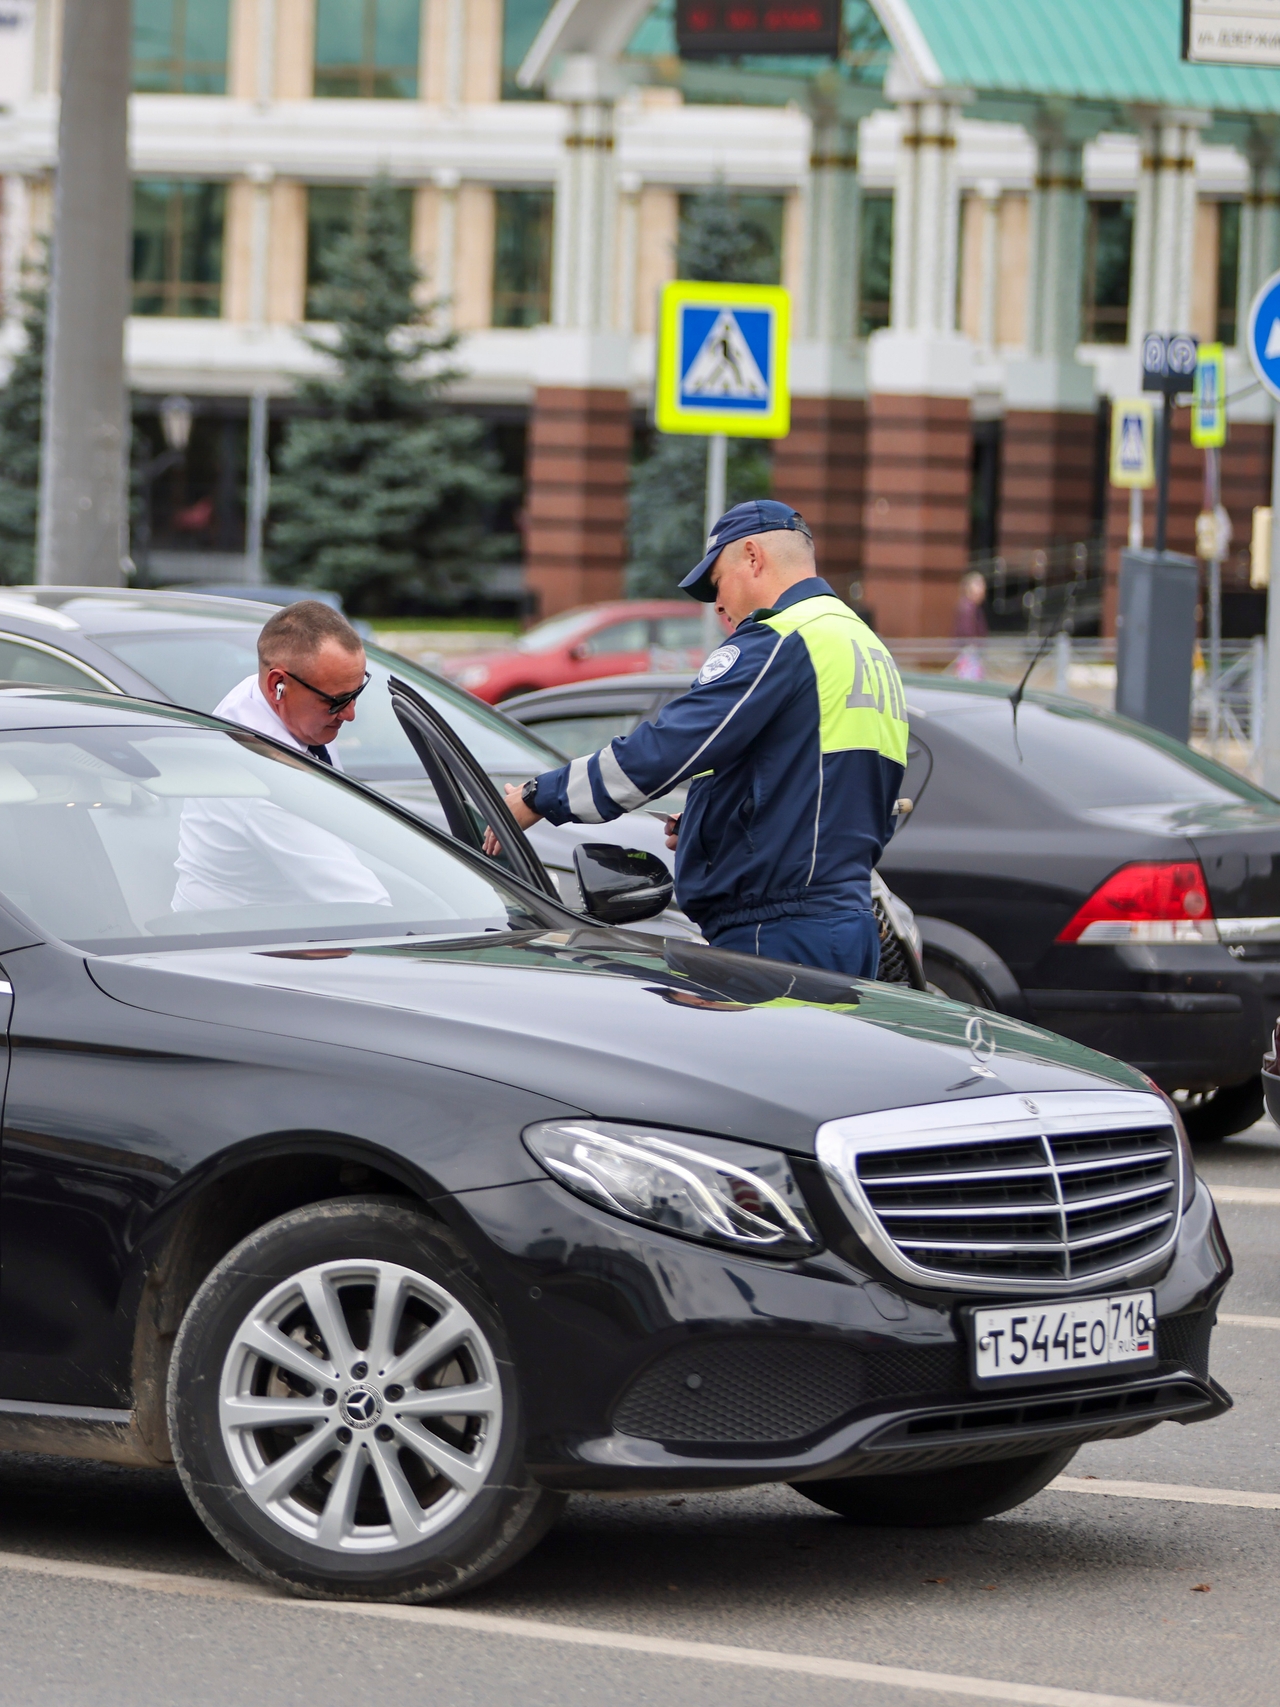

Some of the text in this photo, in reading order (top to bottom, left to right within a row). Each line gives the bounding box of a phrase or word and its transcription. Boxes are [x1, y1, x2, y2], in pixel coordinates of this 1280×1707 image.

[988, 1299, 1148, 1367] Т544ЕО 716
[1118, 1339, 1137, 1354] RUS
